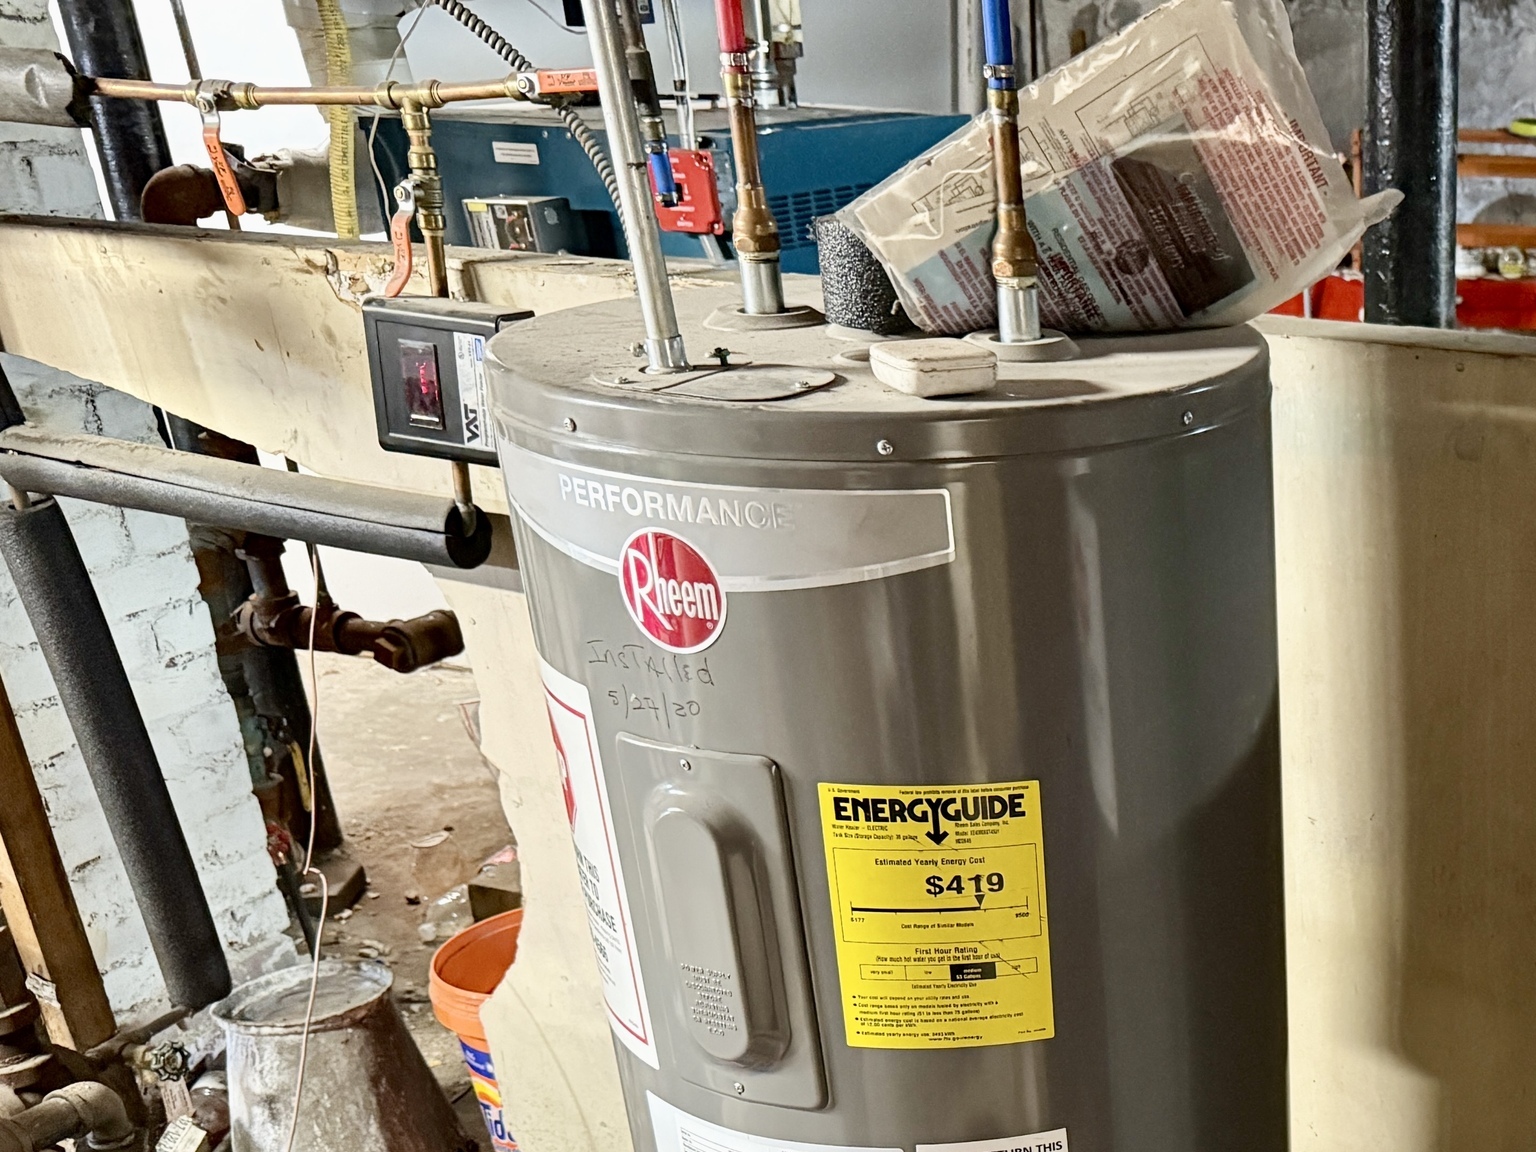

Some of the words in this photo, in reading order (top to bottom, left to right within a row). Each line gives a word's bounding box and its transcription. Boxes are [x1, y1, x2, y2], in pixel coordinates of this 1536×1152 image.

[464, 403, 480, 443] VAT
[558, 473, 795, 529] PERFORMANCE
[627, 532, 720, 631] Rheem
[833, 793, 1026, 825] ENERGYGUIDE
[875, 858, 912, 866] Estimated
[914, 857, 939, 867] Yearly
[941, 857, 966, 866] Energy
[969, 856, 985, 864] Cost
[925, 872, 1005, 898] $419
[915, 947, 932, 955] First
[954, 946, 978, 955] Rating
[481, 1103, 516, 1142] Tid
[1035, 1141, 1063, 1152] THIS
